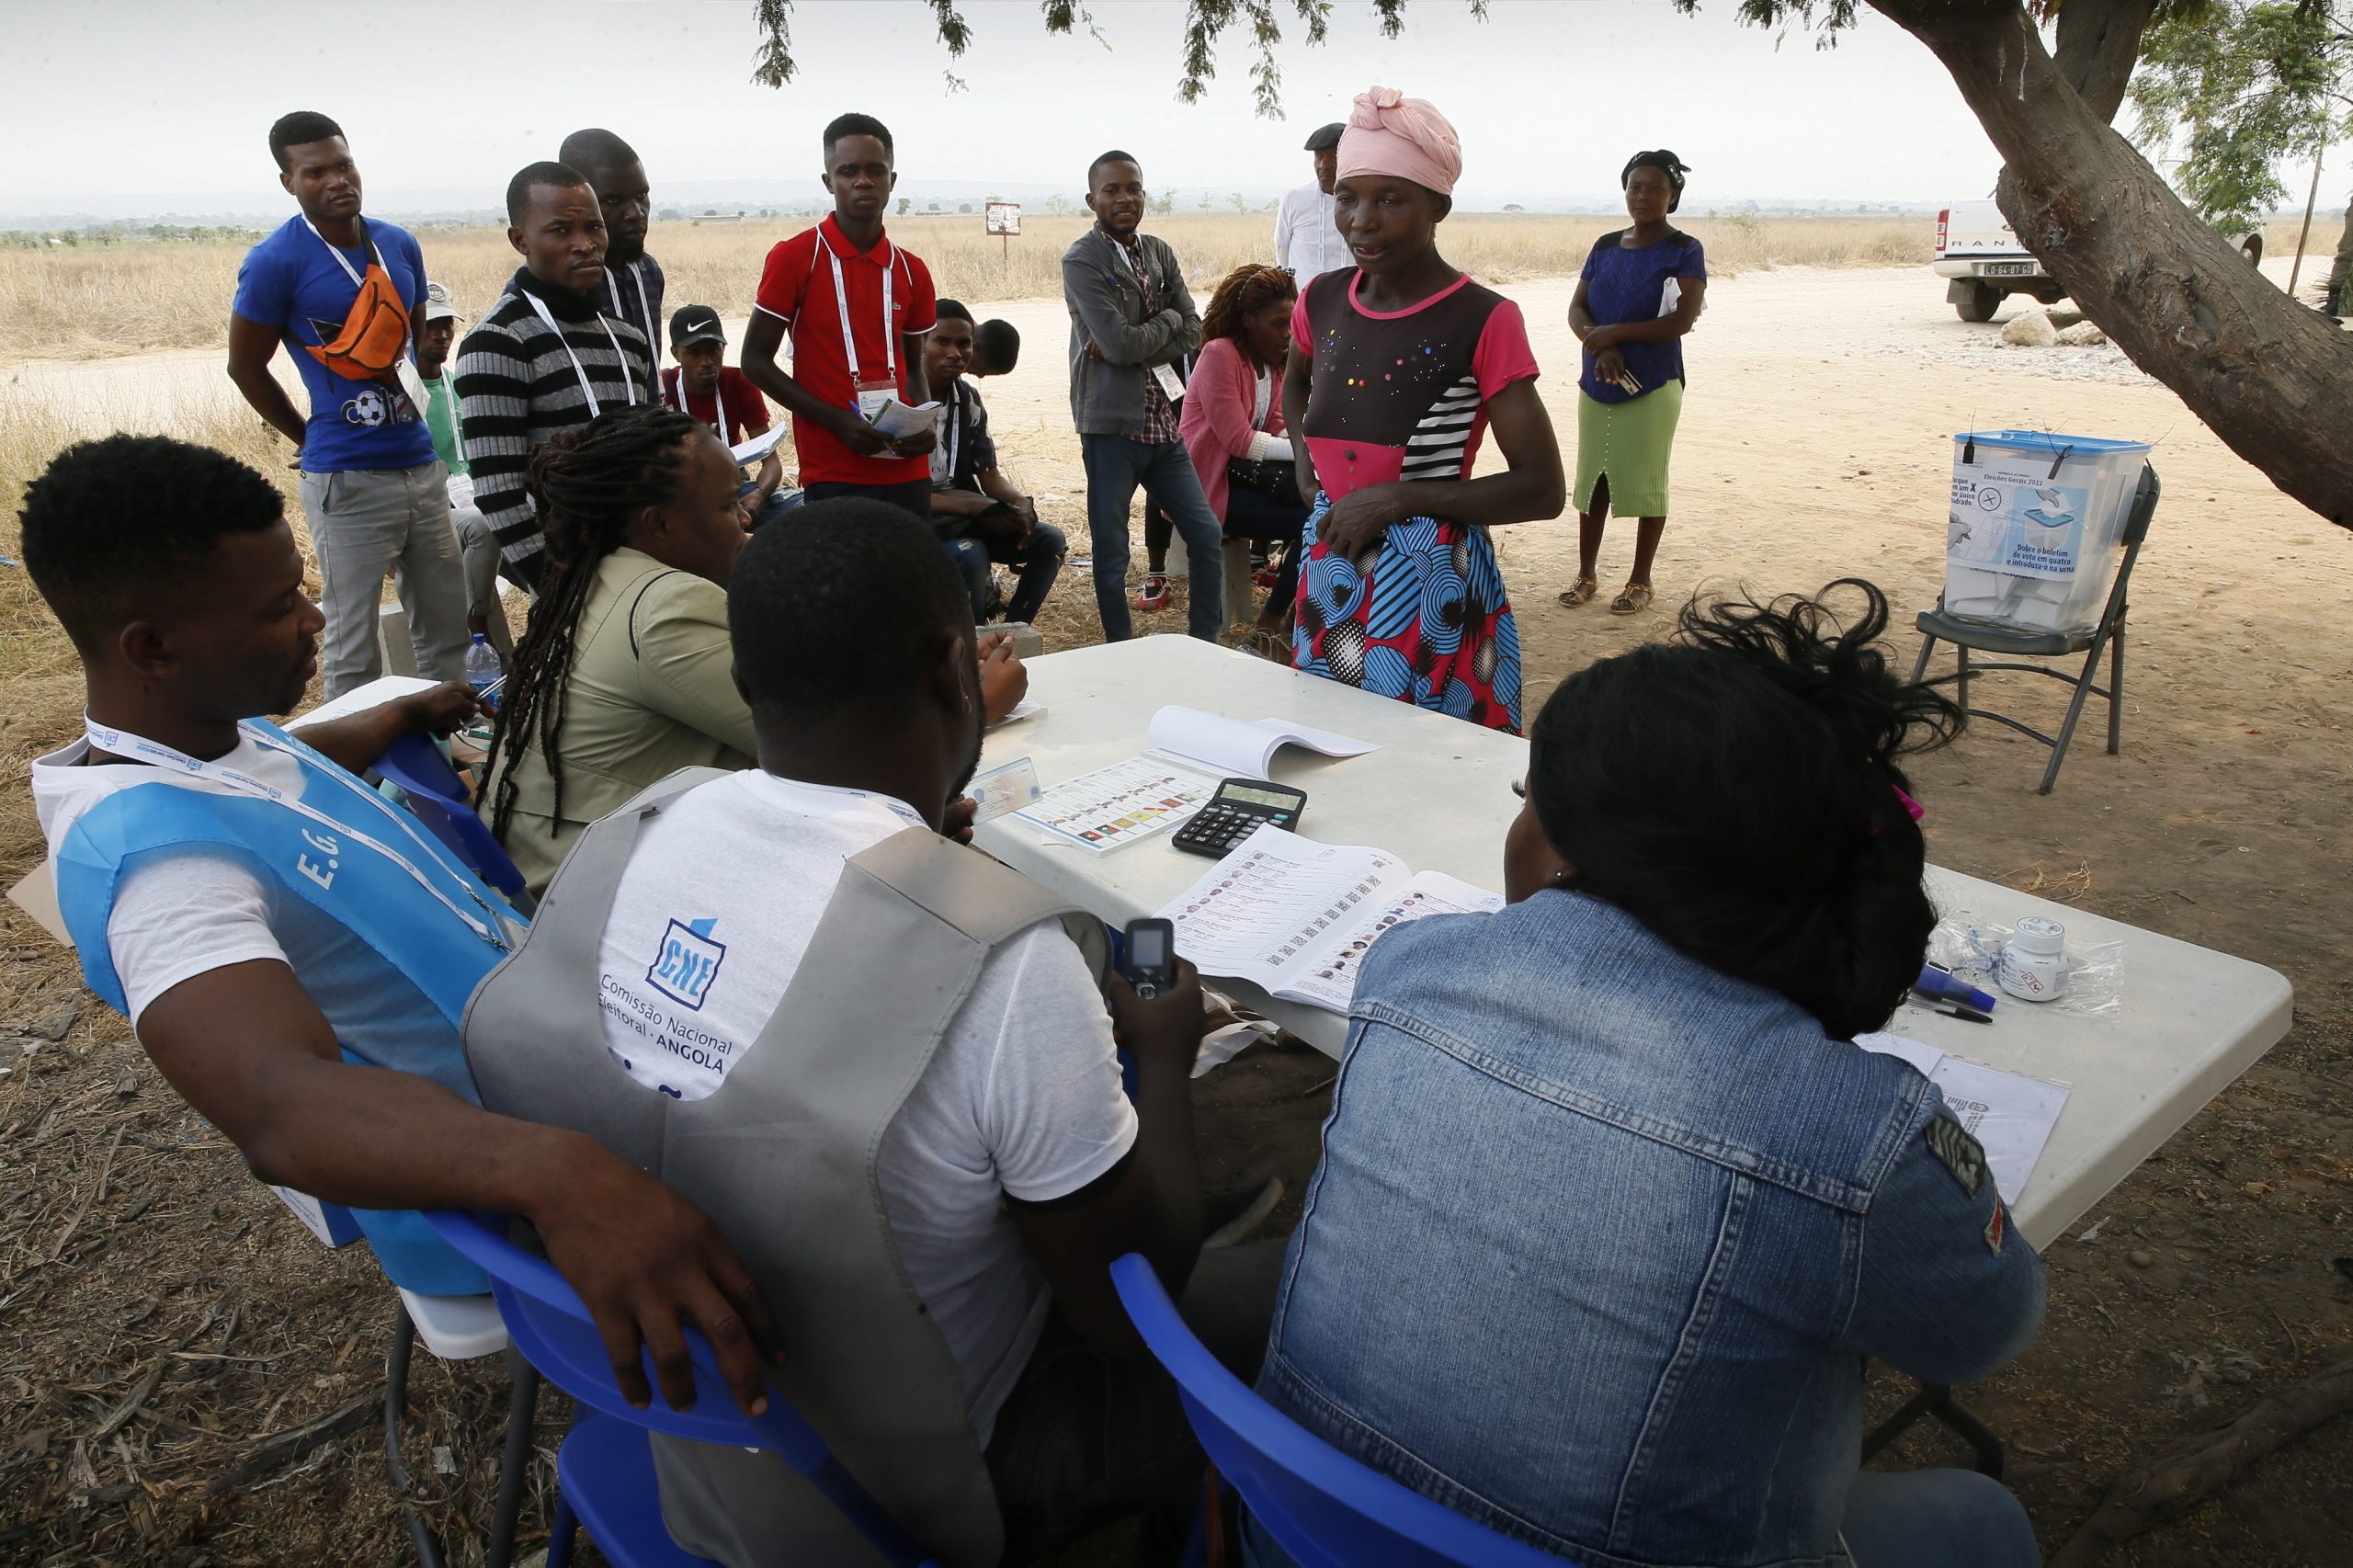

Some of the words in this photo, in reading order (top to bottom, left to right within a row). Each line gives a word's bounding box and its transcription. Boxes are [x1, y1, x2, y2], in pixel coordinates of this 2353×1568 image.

[1984, 473, 2007, 483] Eleições
[2008, 476, 2027, 484] Gerais
[2017, 543, 2036, 553] Dobre
[2042, 546, 2068, 557] boletim
[2012, 551, 2021, 559] de
[2022, 552, 2036, 561] voto
[2049, 557, 2072, 566] quatro
[2012, 559, 2048, 570] introduza-o
[656, 938, 714, 997] CNE
[601, 973, 663, 1026] Comissão
[666, 1017, 733, 1056] Nacional
[597, 992, 646, 1037] Eleitoral
[656, 1034, 724, 1074] ANGOLA
